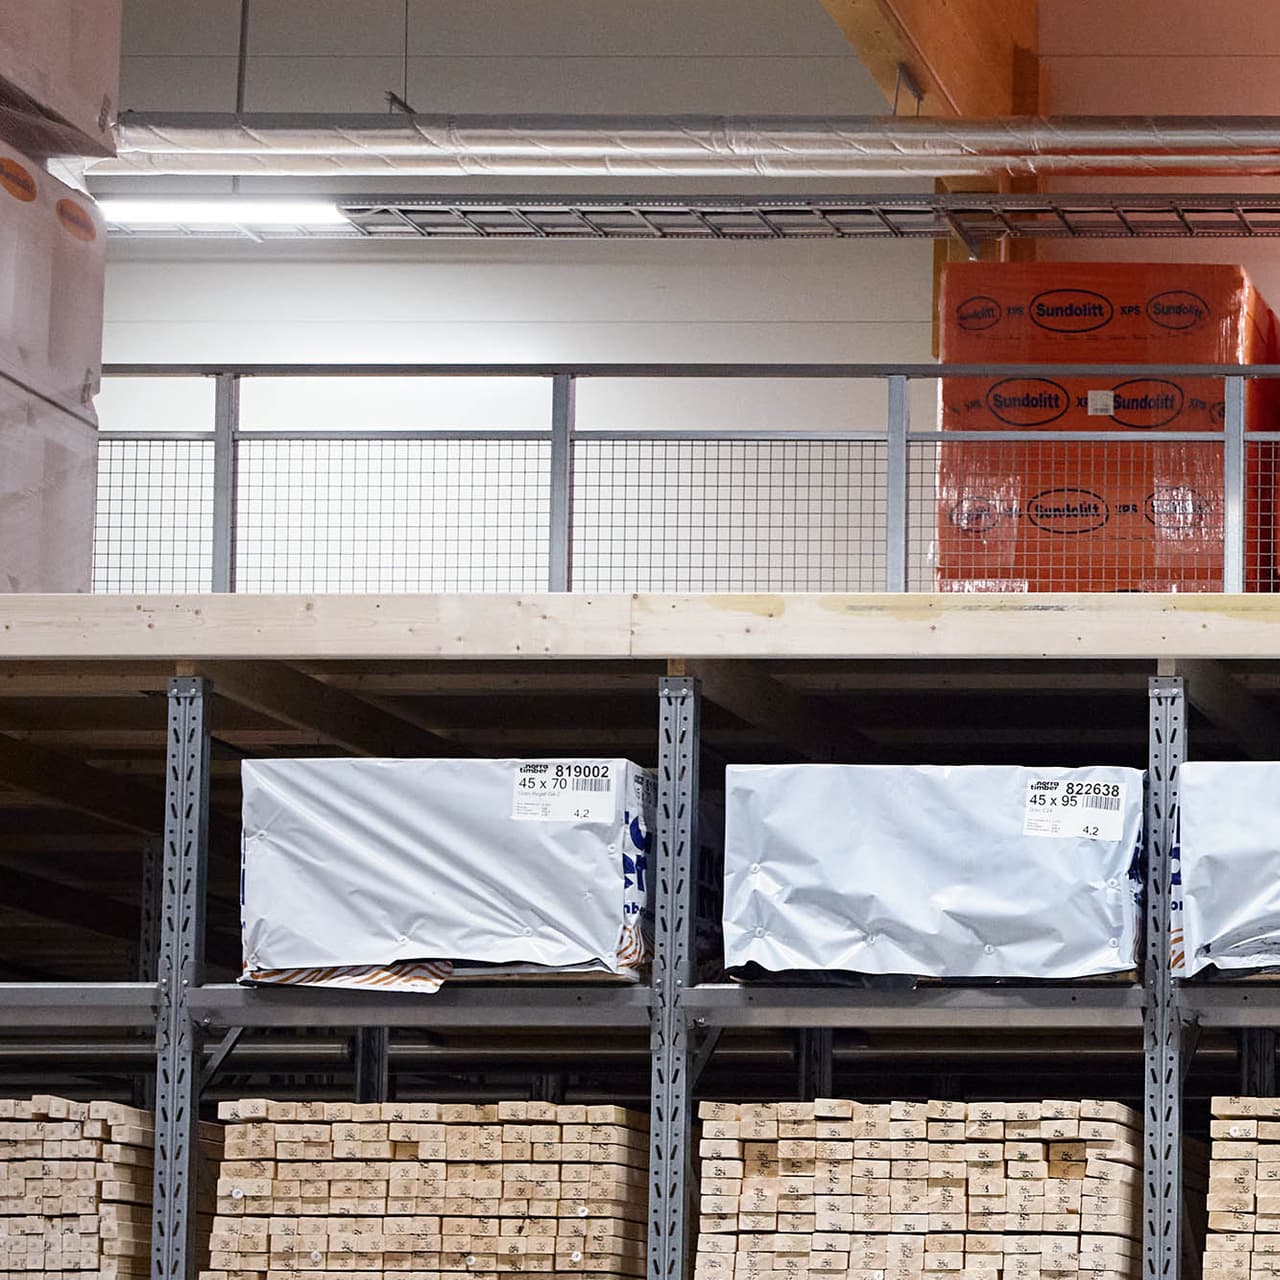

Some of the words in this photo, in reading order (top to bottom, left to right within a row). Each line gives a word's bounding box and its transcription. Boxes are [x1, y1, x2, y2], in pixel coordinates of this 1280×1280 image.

[1036, 304, 1104, 317] Sundolitt
[1120, 306, 1140, 315] XPS
[993, 393, 1060, 408] Sundolitt
[1113, 394, 1175, 409] Sundolitt
[555, 765, 609, 778] 819002
[519, 778, 536, 789] 45
[540, 781, 547, 789] x
[552, 778, 567, 789] 70
[1066, 783, 1120, 796] 822638
[1030, 795, 1046, 805] 45
[1050, 797, 1057, 806] x
[1062, 795, 1078, 806] 95
